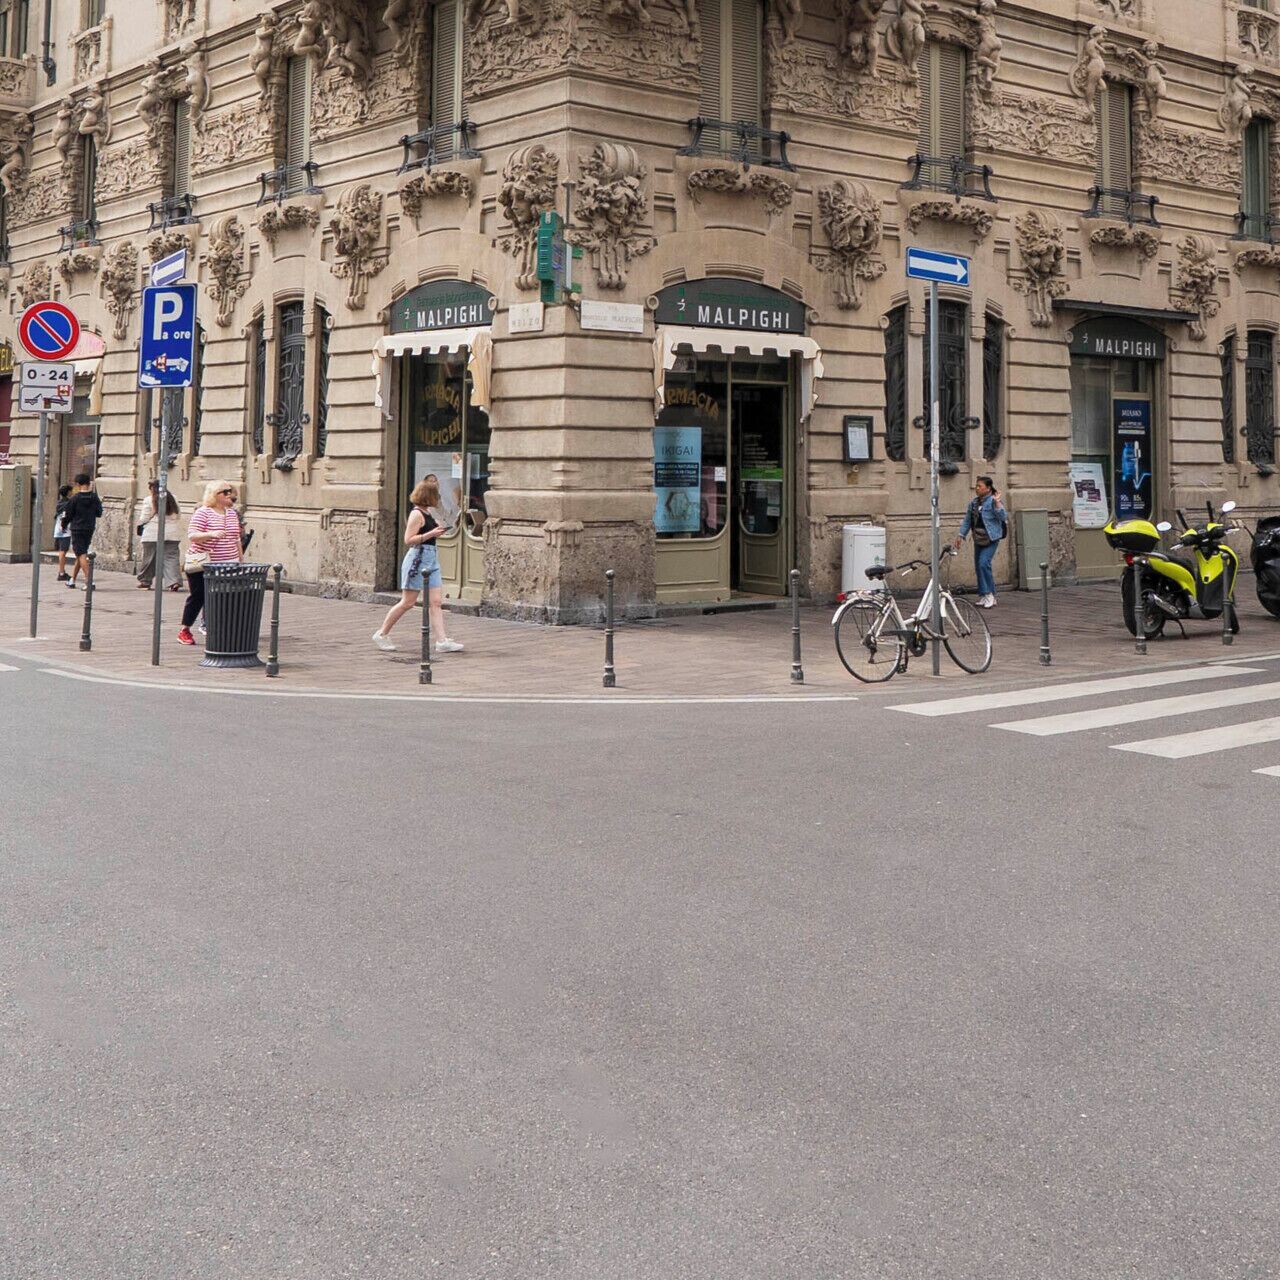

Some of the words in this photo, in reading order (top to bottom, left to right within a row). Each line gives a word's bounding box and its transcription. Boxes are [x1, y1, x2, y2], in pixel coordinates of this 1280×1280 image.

[417, 304, 483, 328] MALPIGHI
[698, 305, 790, 329] MALPIGHI
[173, 330, 191, 339] ore
[1095, 338, 1157, 357] MALPIGHI
[48, 370, 69, 381] 24
[662, 446, 694, 456] IKIGAI
